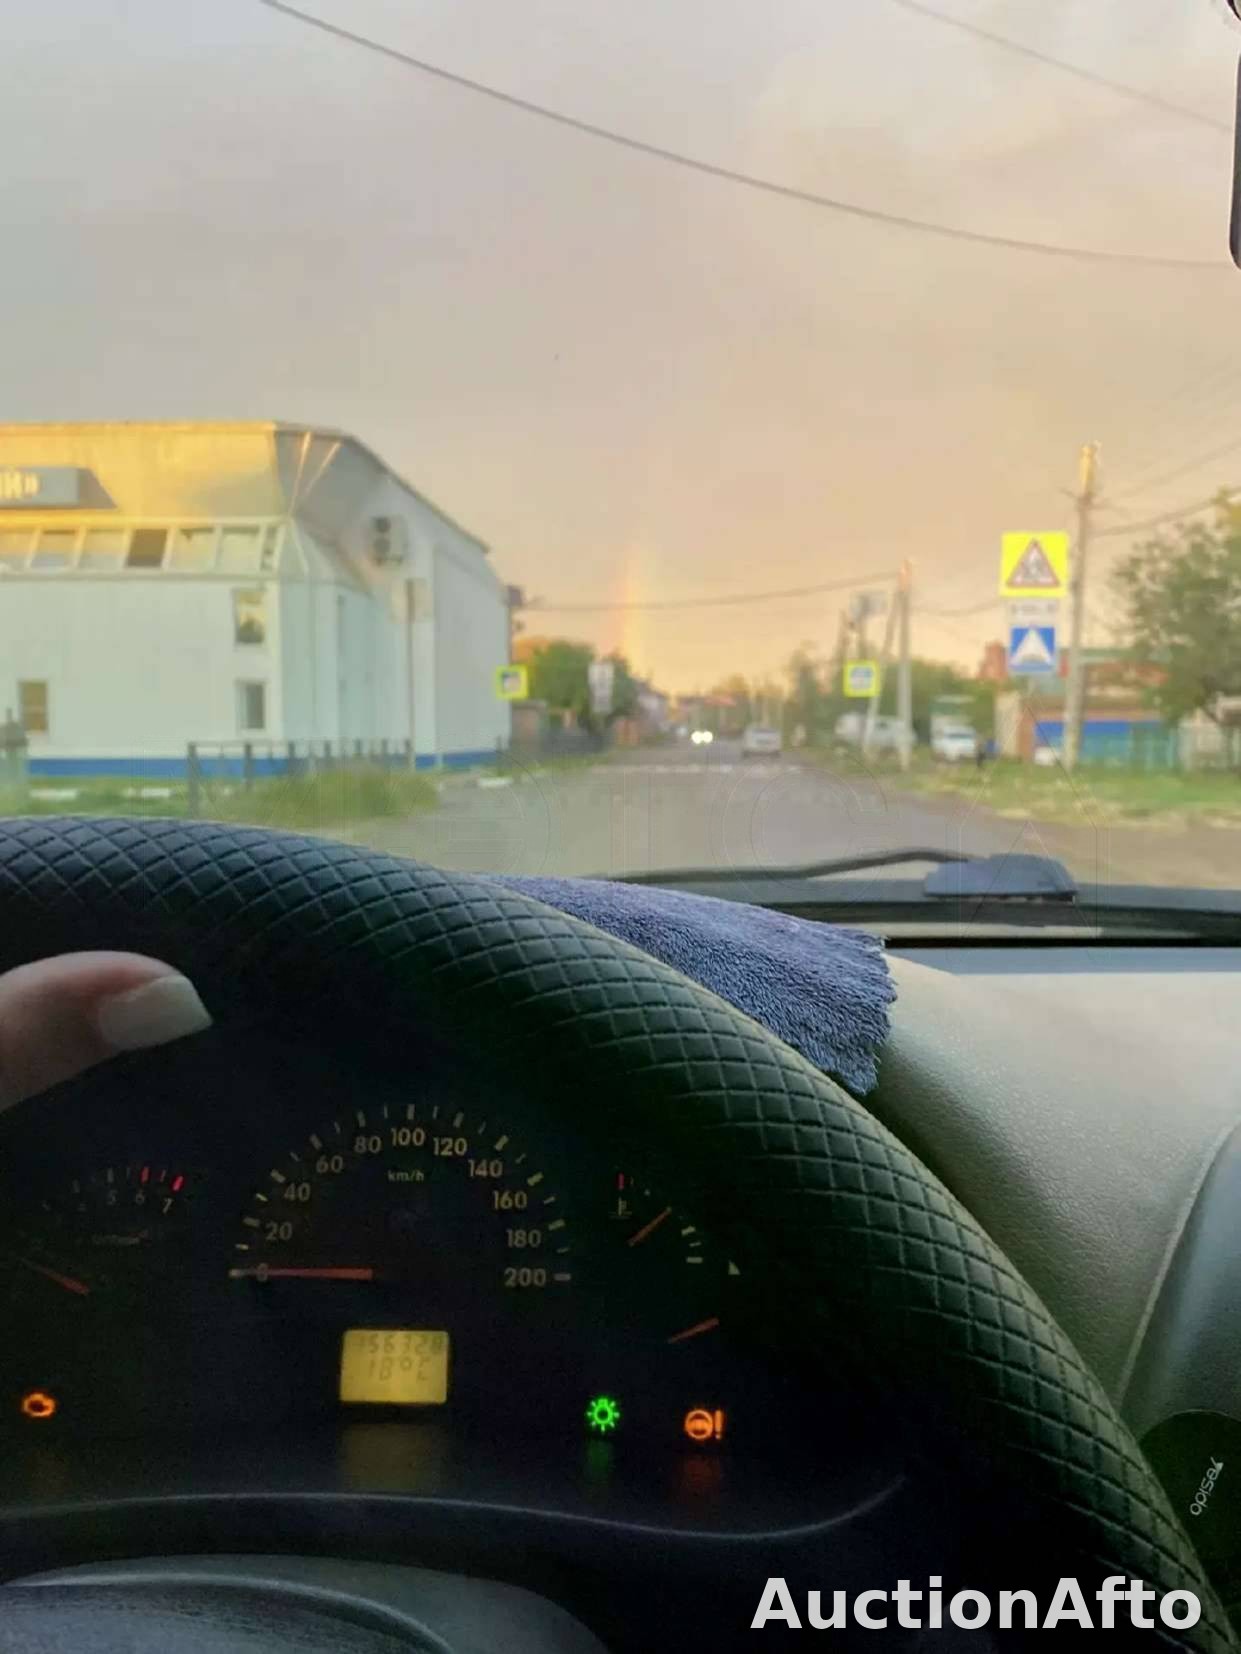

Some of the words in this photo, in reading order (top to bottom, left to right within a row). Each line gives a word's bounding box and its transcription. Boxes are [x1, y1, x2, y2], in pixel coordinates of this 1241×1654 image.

[353, 1136, 383, 1154] 80
[390, 1127, 426, 1148] 100
[433, 1137, 468, 1158] 120
[315, 1155, 344, 1174] 60
[468, 1159, 503, 1179] 140
[387, 1168, 425, 1184] km/h
[283, 1183, 311, 1202] 40
[493, 1190, 528, 1210] 160
[162, 1198, 174, 1214] 7
[265, 1222, 293, 1241] 20
[505, 1229, 541, 1248] 180
[504, 1267, 547, 1287] 200
